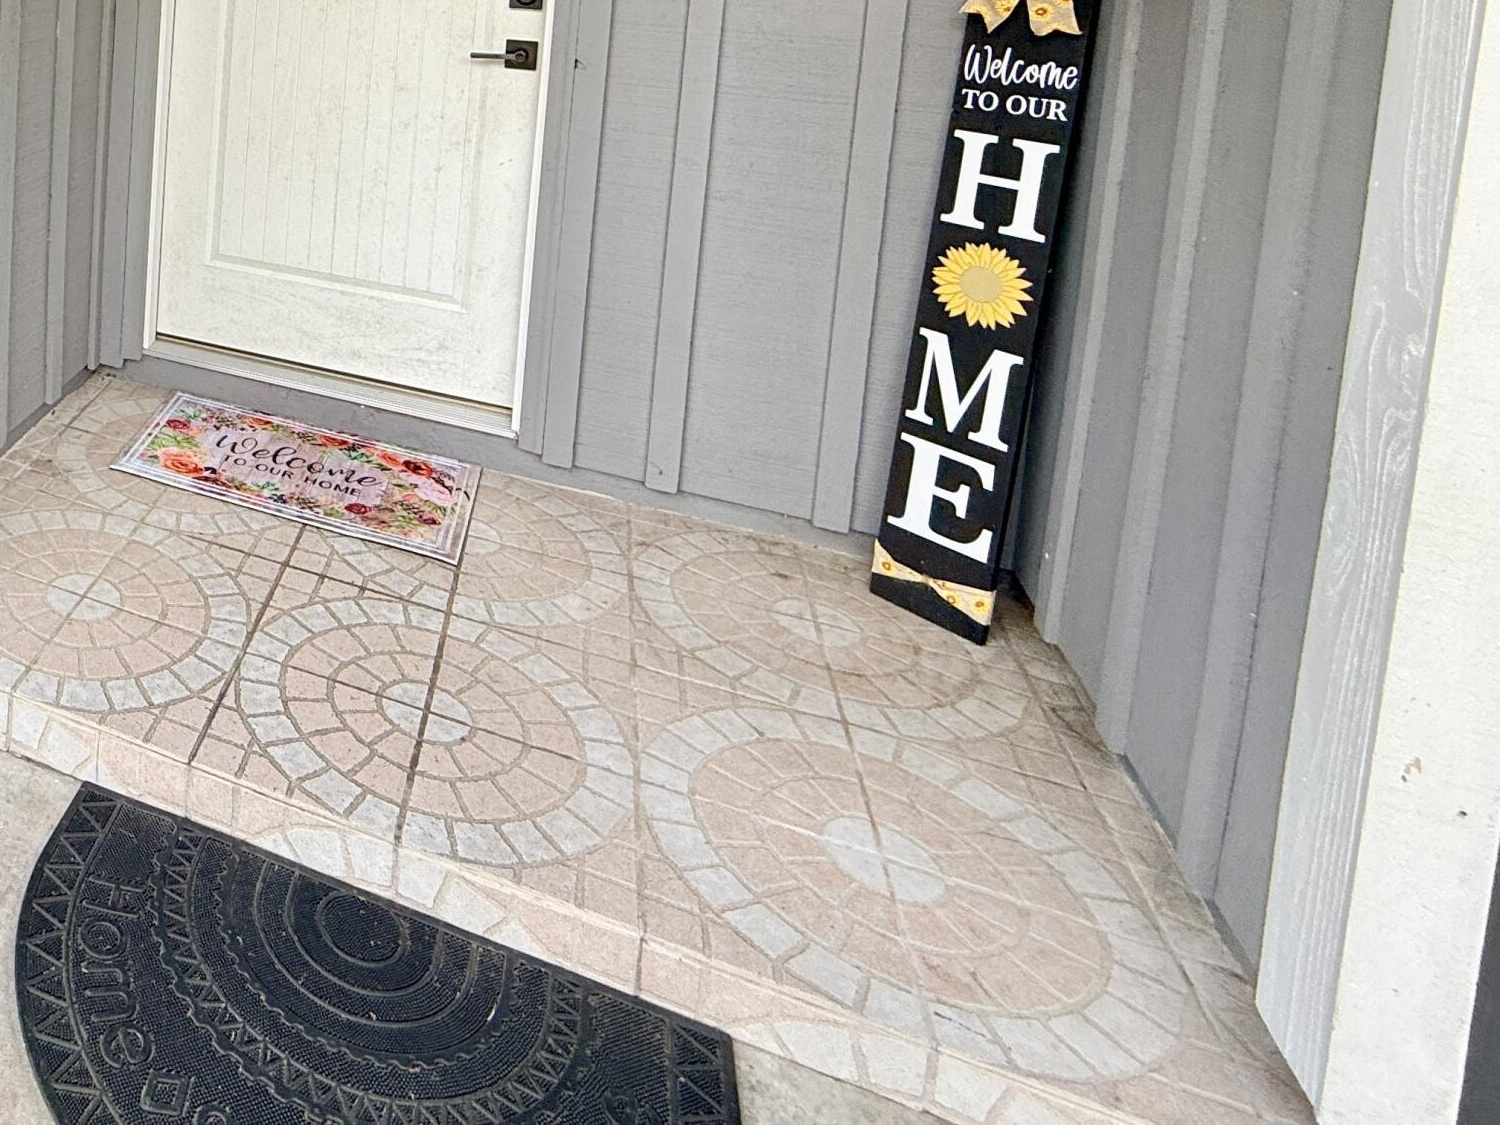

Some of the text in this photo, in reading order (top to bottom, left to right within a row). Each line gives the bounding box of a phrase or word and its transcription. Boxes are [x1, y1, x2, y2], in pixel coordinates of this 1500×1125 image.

[963, 43, 1079, 90] Welcome
[961, 88, 1068, 122] TO OUR
[215, 434, 383, 487] Welcome
[224, 454, 362, 497] TO OUR HOME
